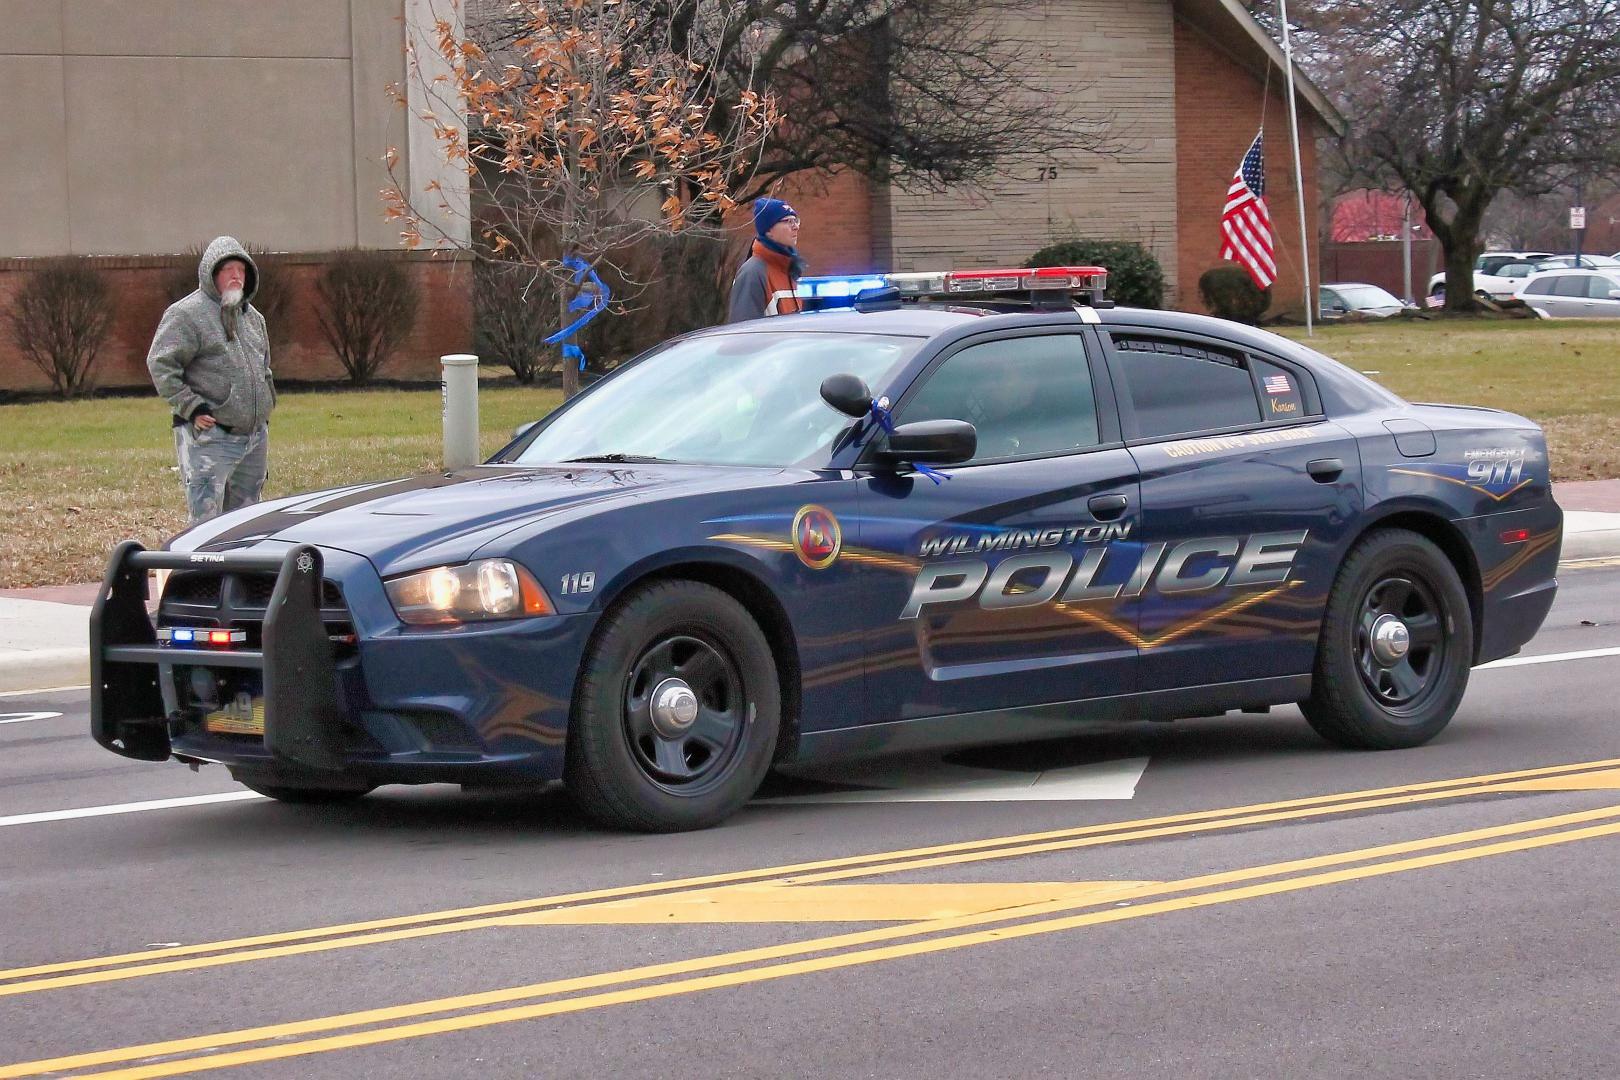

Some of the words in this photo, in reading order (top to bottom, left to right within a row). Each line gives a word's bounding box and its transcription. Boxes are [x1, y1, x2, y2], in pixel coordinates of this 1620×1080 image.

[1038, 166, 1057, 181] 75
[1162, 438, 1223, 458] CAUTION
[1465, 458, 1524, 485] 911
[919, 522, 1133, 557] WILMINGTON
[190, 554, 225, 563] SETINA
[561, 571, 596, 595] 119
[899, 529, 1309, 620] POLICE
